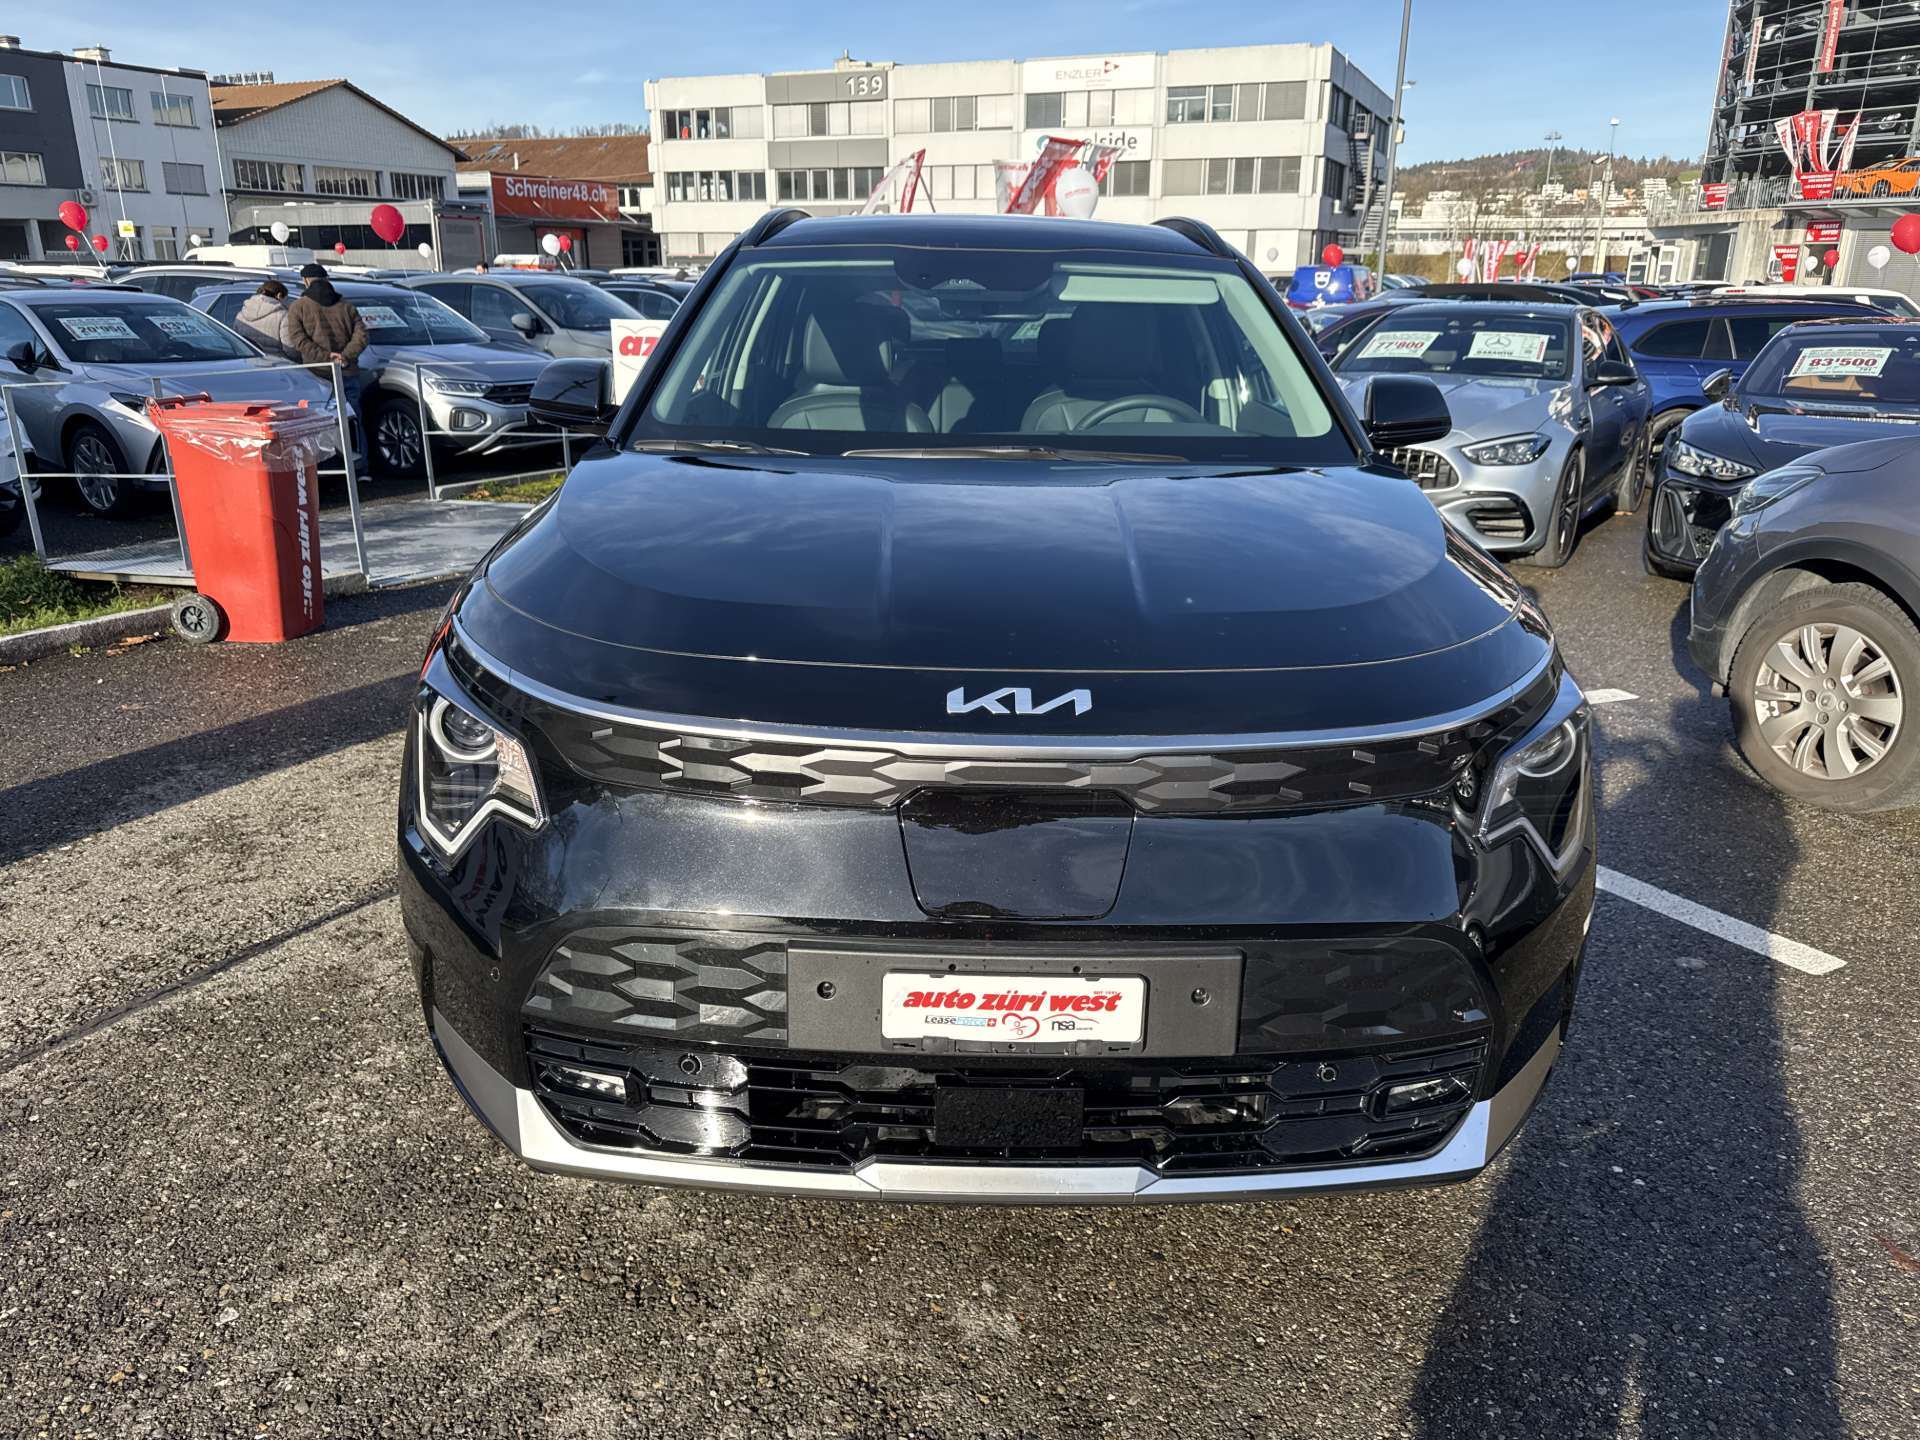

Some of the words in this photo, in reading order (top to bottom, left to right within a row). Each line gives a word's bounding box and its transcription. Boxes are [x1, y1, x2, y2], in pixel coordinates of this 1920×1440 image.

[1055, 68, 1102, 80] ENZLER
[846, 75, 883, 96] 139
[505, 176, 608, 202] Schreiner48.ch
[1808, 357, 1878, 367] 83'500
[297, 508, 312, 563] züri
[946, 686, 1092, 716] KIA
[903, 989, 977, 1010] auto
[976, 990, 1048, 1012] züri
[1049, 992, 1123, 1013] west
[1051, 1019, 1076, 1031] nsa
